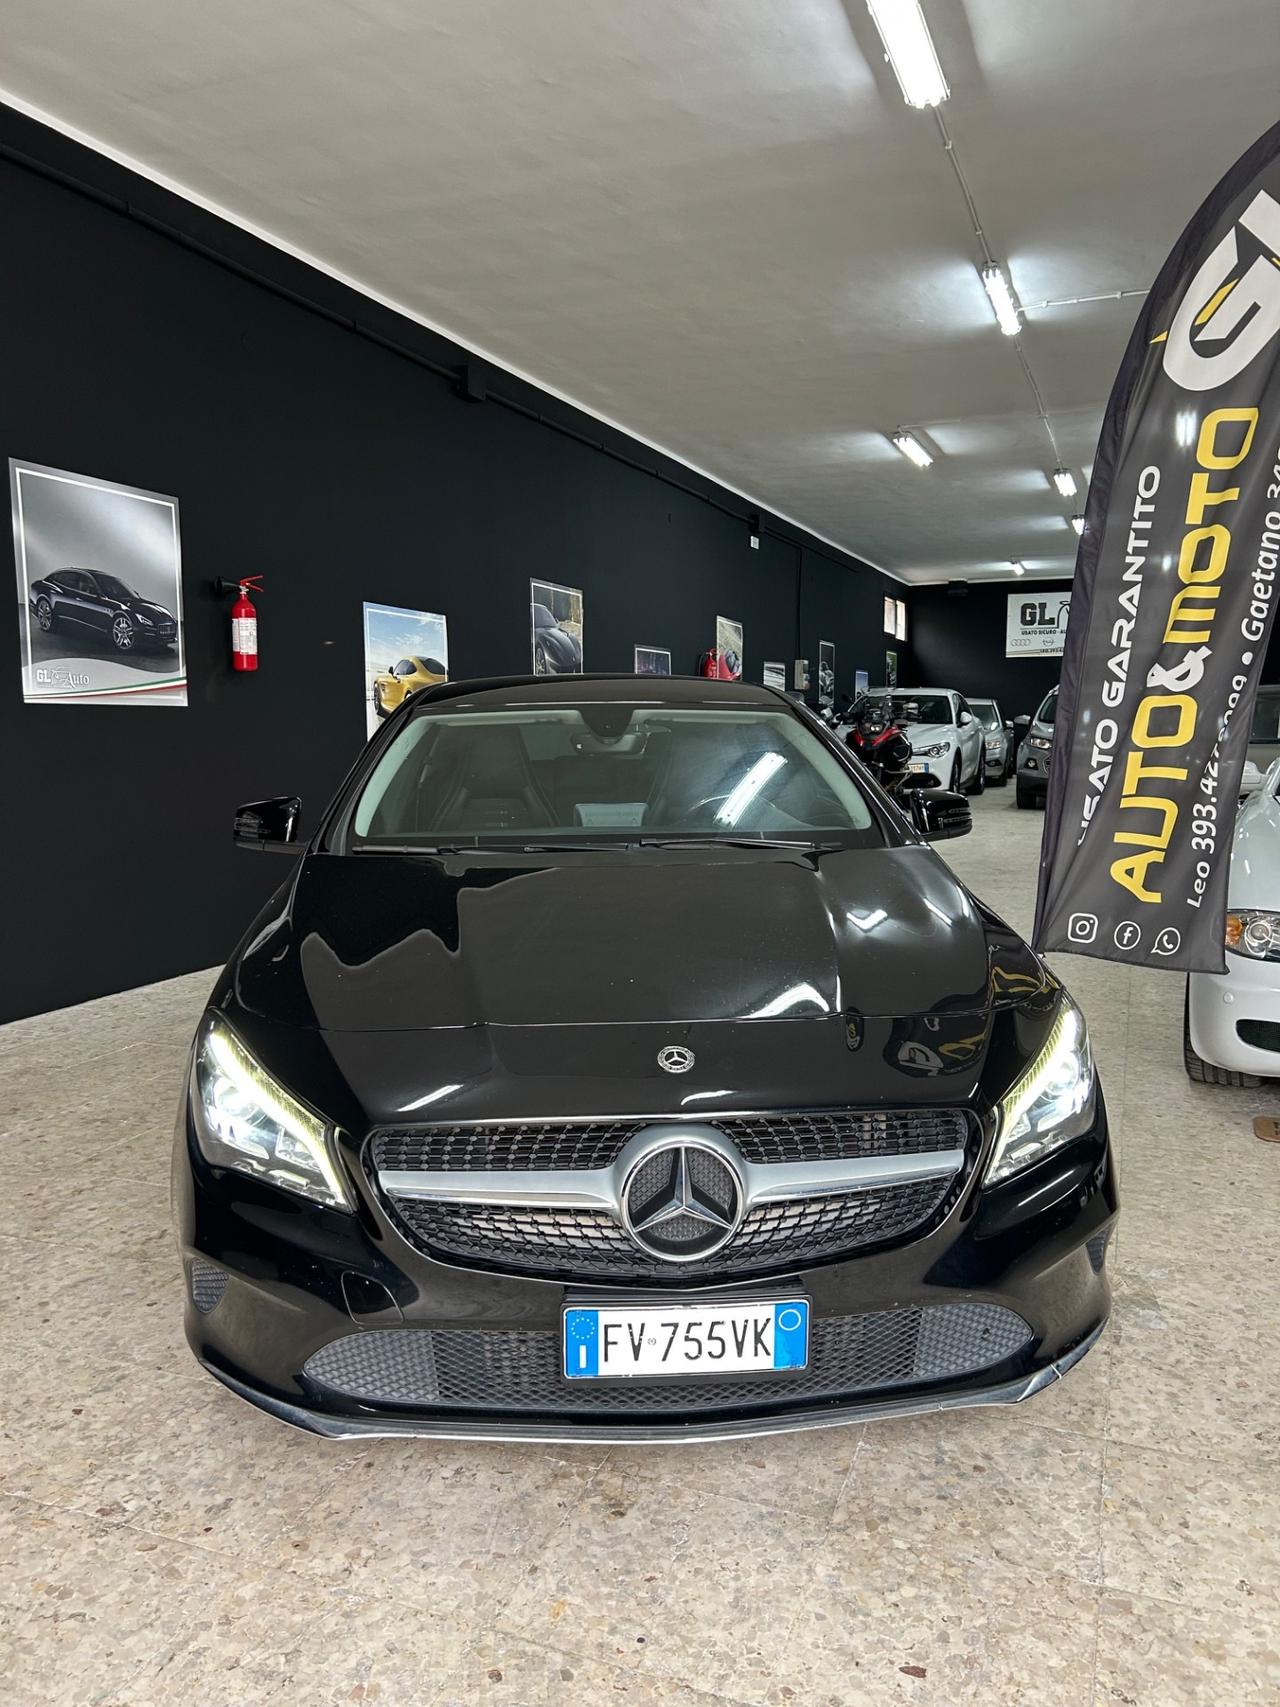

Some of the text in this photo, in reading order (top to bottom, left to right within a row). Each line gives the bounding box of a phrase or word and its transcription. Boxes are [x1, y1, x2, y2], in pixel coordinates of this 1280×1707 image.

[1020, 602, 1056, 626] GL
[1101, 465, 1161, 707] GARANTITO
[36, 669, 90, 689] GL Auto
[1186, 860, 1211, 908] Leo
[1241, 511, 1280, 642] Gaetano
